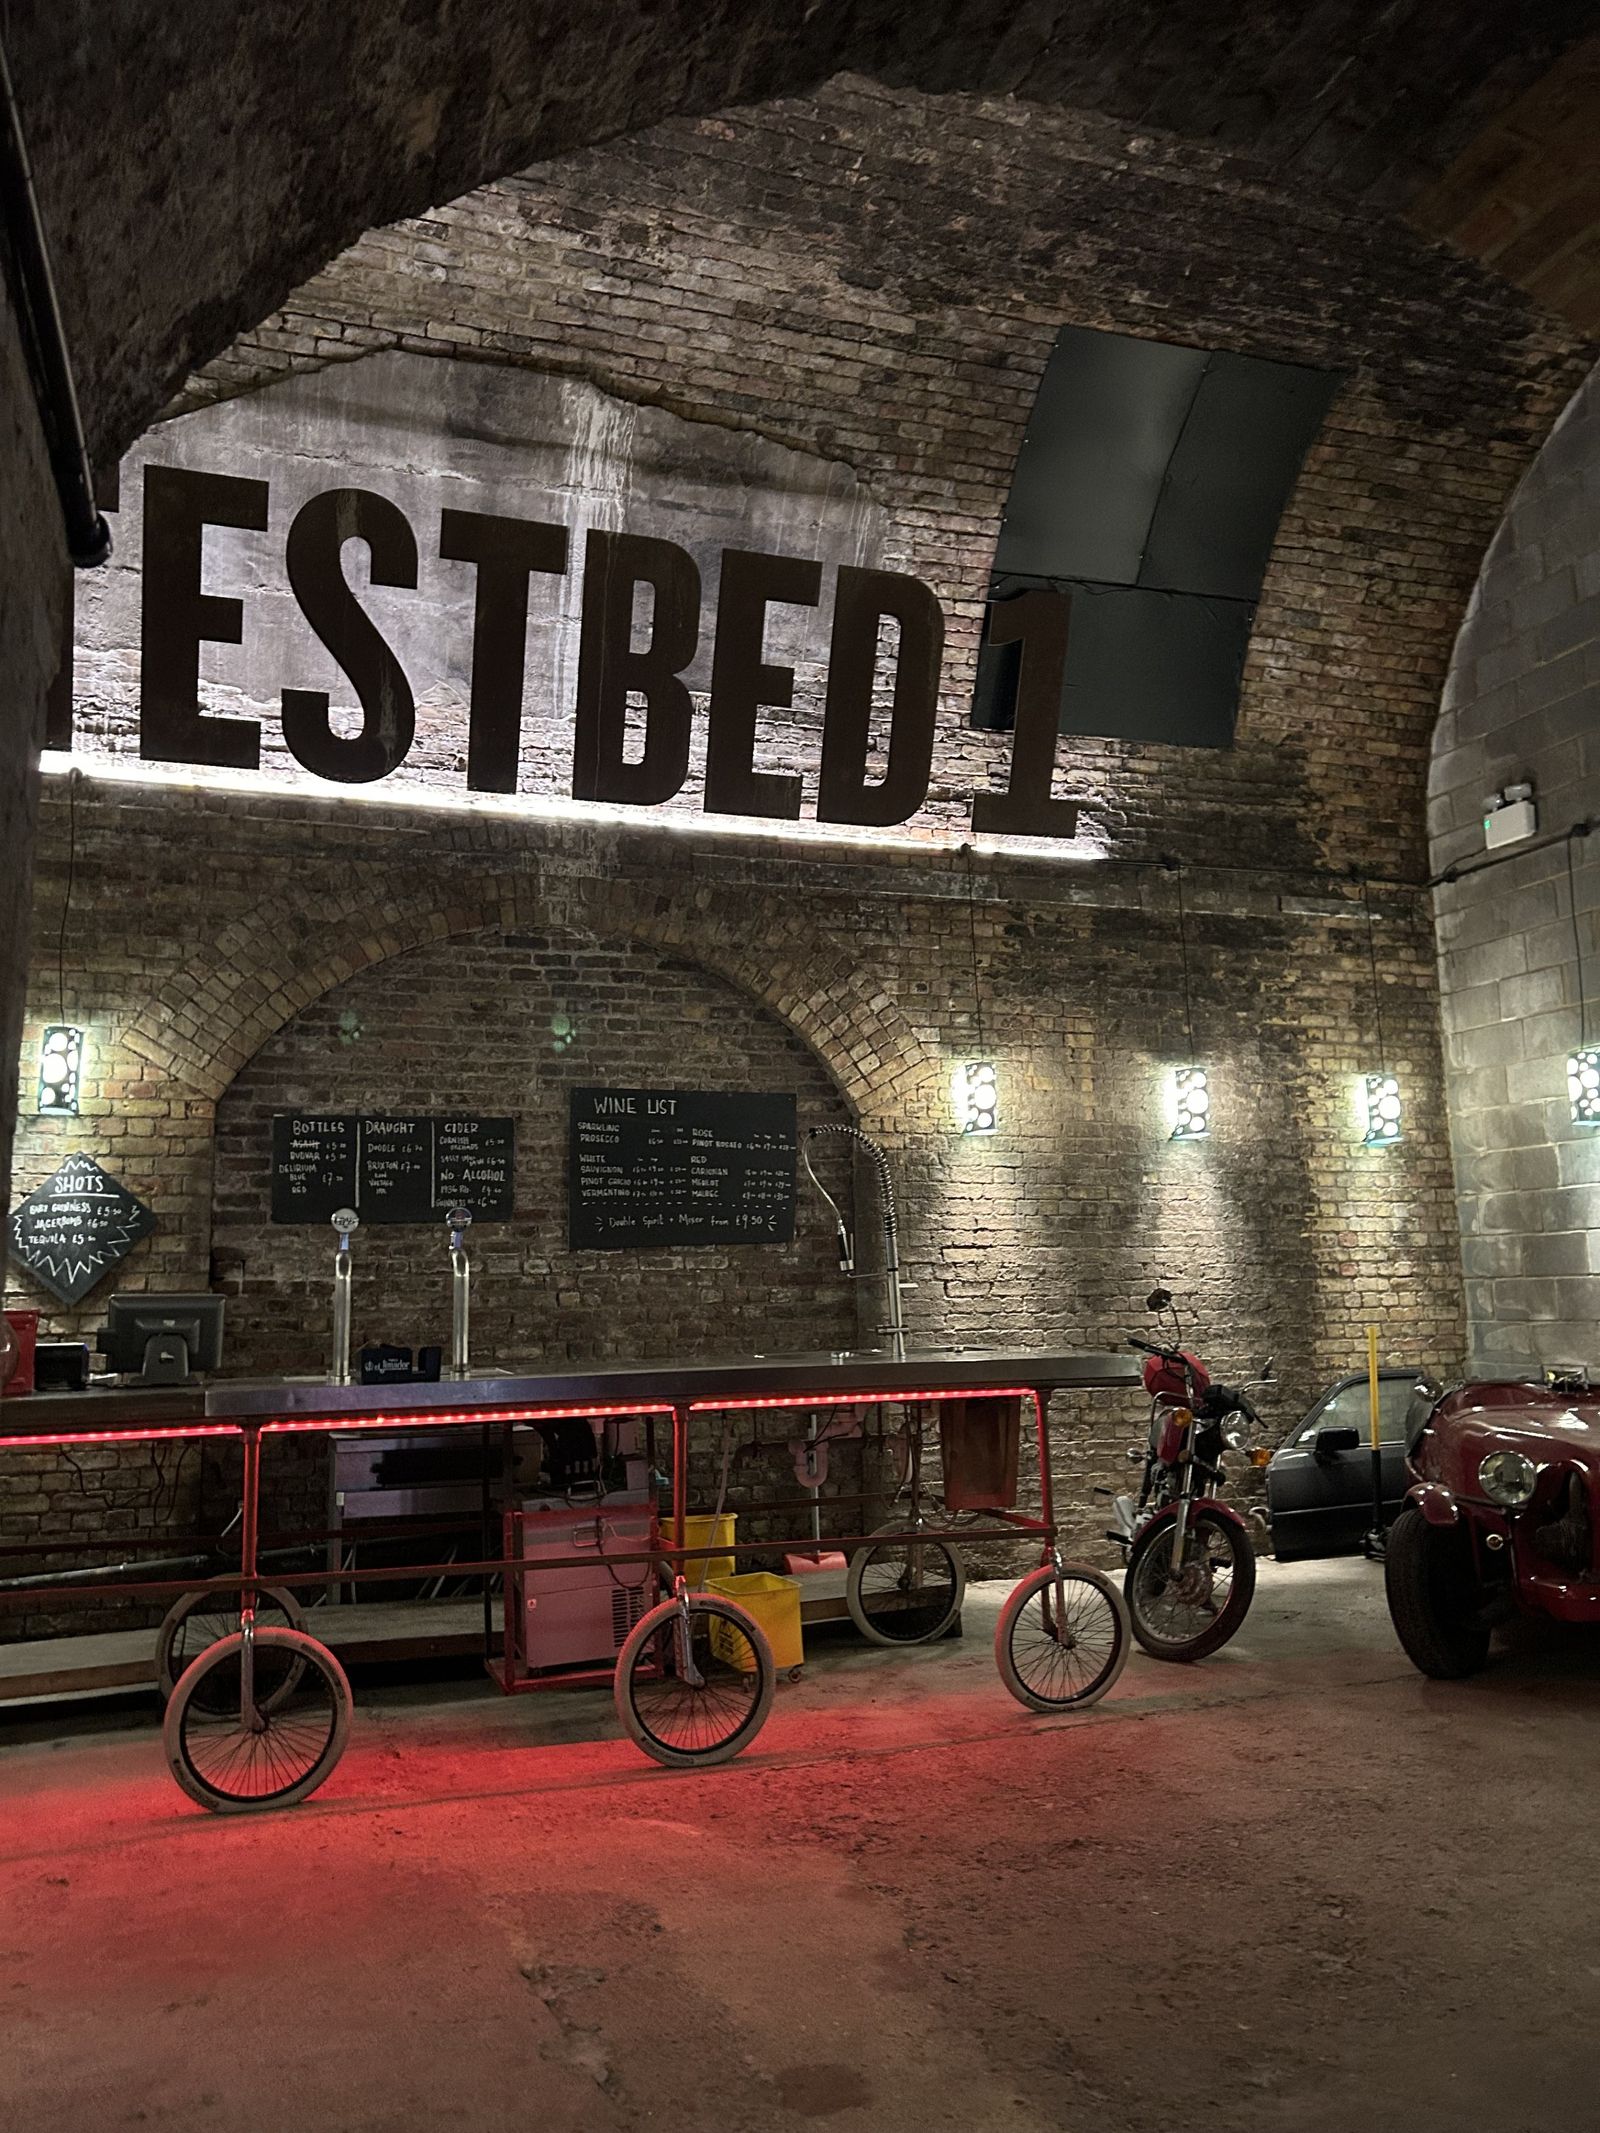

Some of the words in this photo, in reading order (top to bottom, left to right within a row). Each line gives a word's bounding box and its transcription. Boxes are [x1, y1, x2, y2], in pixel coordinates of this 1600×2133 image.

[594, 1097, 637, 1115] WINE
[647, 1099, 677, 1115] LIST
[292, 1120, 345, 1135] BOTTLES
[365, 1120, 415, 1135] DRAUGHT
[444, 1122, 479, 1133] CIDER
[577, 1122, 620, 1132] SPARKLING
[580, 1134, 620, 1144] PROSECCO
[579, 1154, 606, 1163] WHITE
[690, 1155, 708, 1164] RED
[278, 1163, 317, 1173] DELIRIUM
[367, 1160, 399, 1171] BRIXTON
[462, 1168, 507, 1182] ALCOHOL
[54, 1175, 104, 1193] SHOTS
[580, 1177, 604, 1186] PINOT
[609, 1216, 636, 1227] Double
[642, 1214, 664, 1228] Spirit
[28, 1233, 67, 1244] TEQUILA
